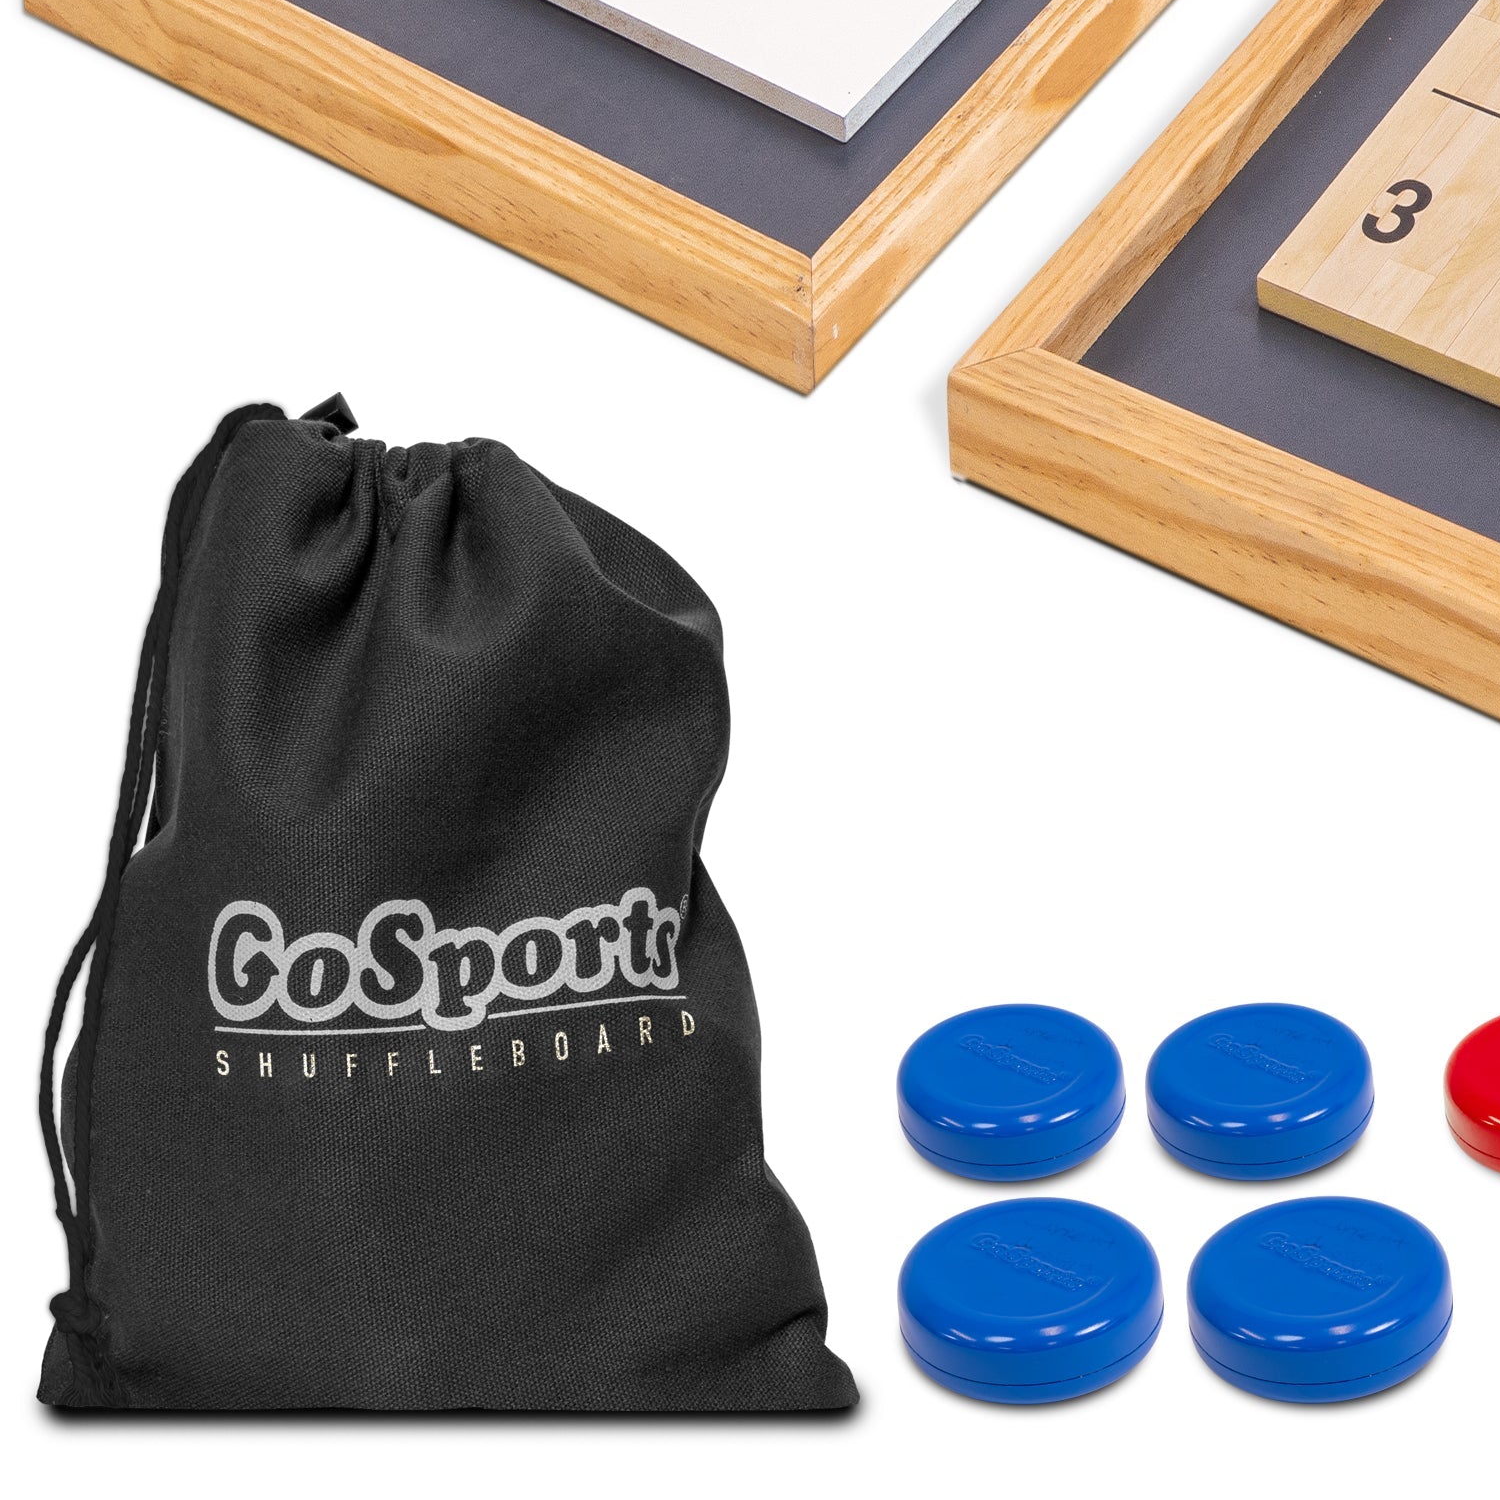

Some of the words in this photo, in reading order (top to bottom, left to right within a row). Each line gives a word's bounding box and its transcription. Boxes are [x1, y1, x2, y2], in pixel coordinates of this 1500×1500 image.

[1361, 179, 1433, 244] 3
[208, 886, 682, 1032] GoSports
[215, 1010, 697, 1079] SHUFFLEBOARD
